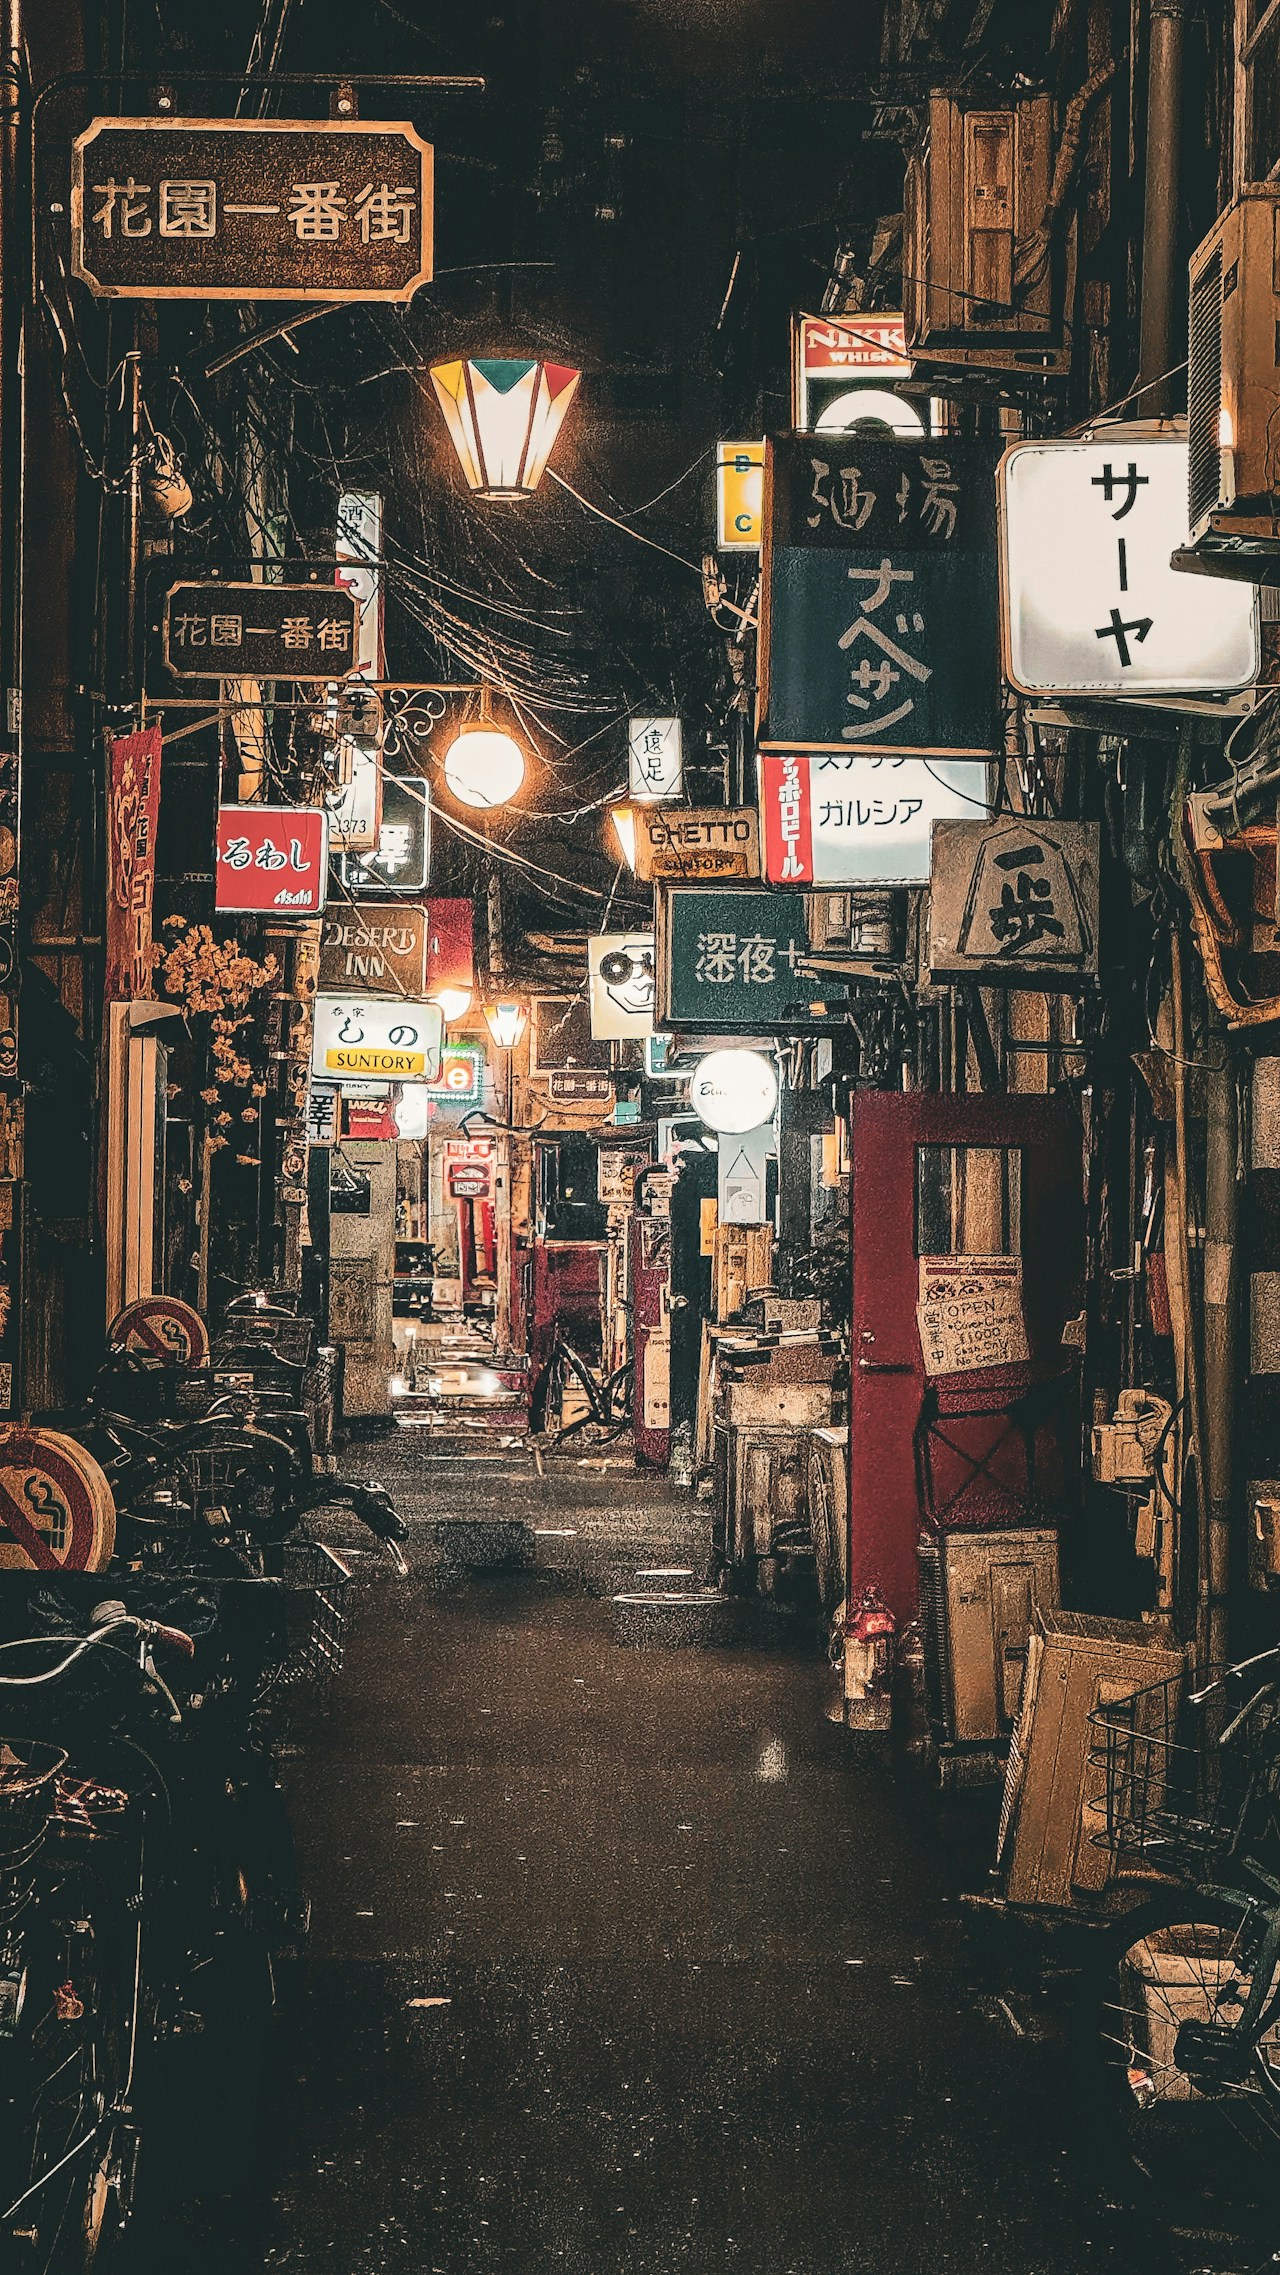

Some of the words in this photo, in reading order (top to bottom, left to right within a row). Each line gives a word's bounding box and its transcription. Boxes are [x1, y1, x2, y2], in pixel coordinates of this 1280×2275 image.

[91, 176, 417, 244] 花園一番街
[807, 456, 962, 540] 酒場
[1091, 463, 1154, 667] サーヤ
[173, 613, 352, 652] 花園一番街
[837, 558, 932, 739] ナベサン
[643, 729, 665, 782] 遠足
[649, 819, 750, 845] GHETTO
[819, 798, 923, 827] ガルシア
[273, 889, 313, 905] Asahi
[987, 843, 1066, 956] 一歩
[324, 922, 417, 955] DESERT
[345, 952, 385, 977] INN
[337, 1053, 416, 1070] SUNTORY
